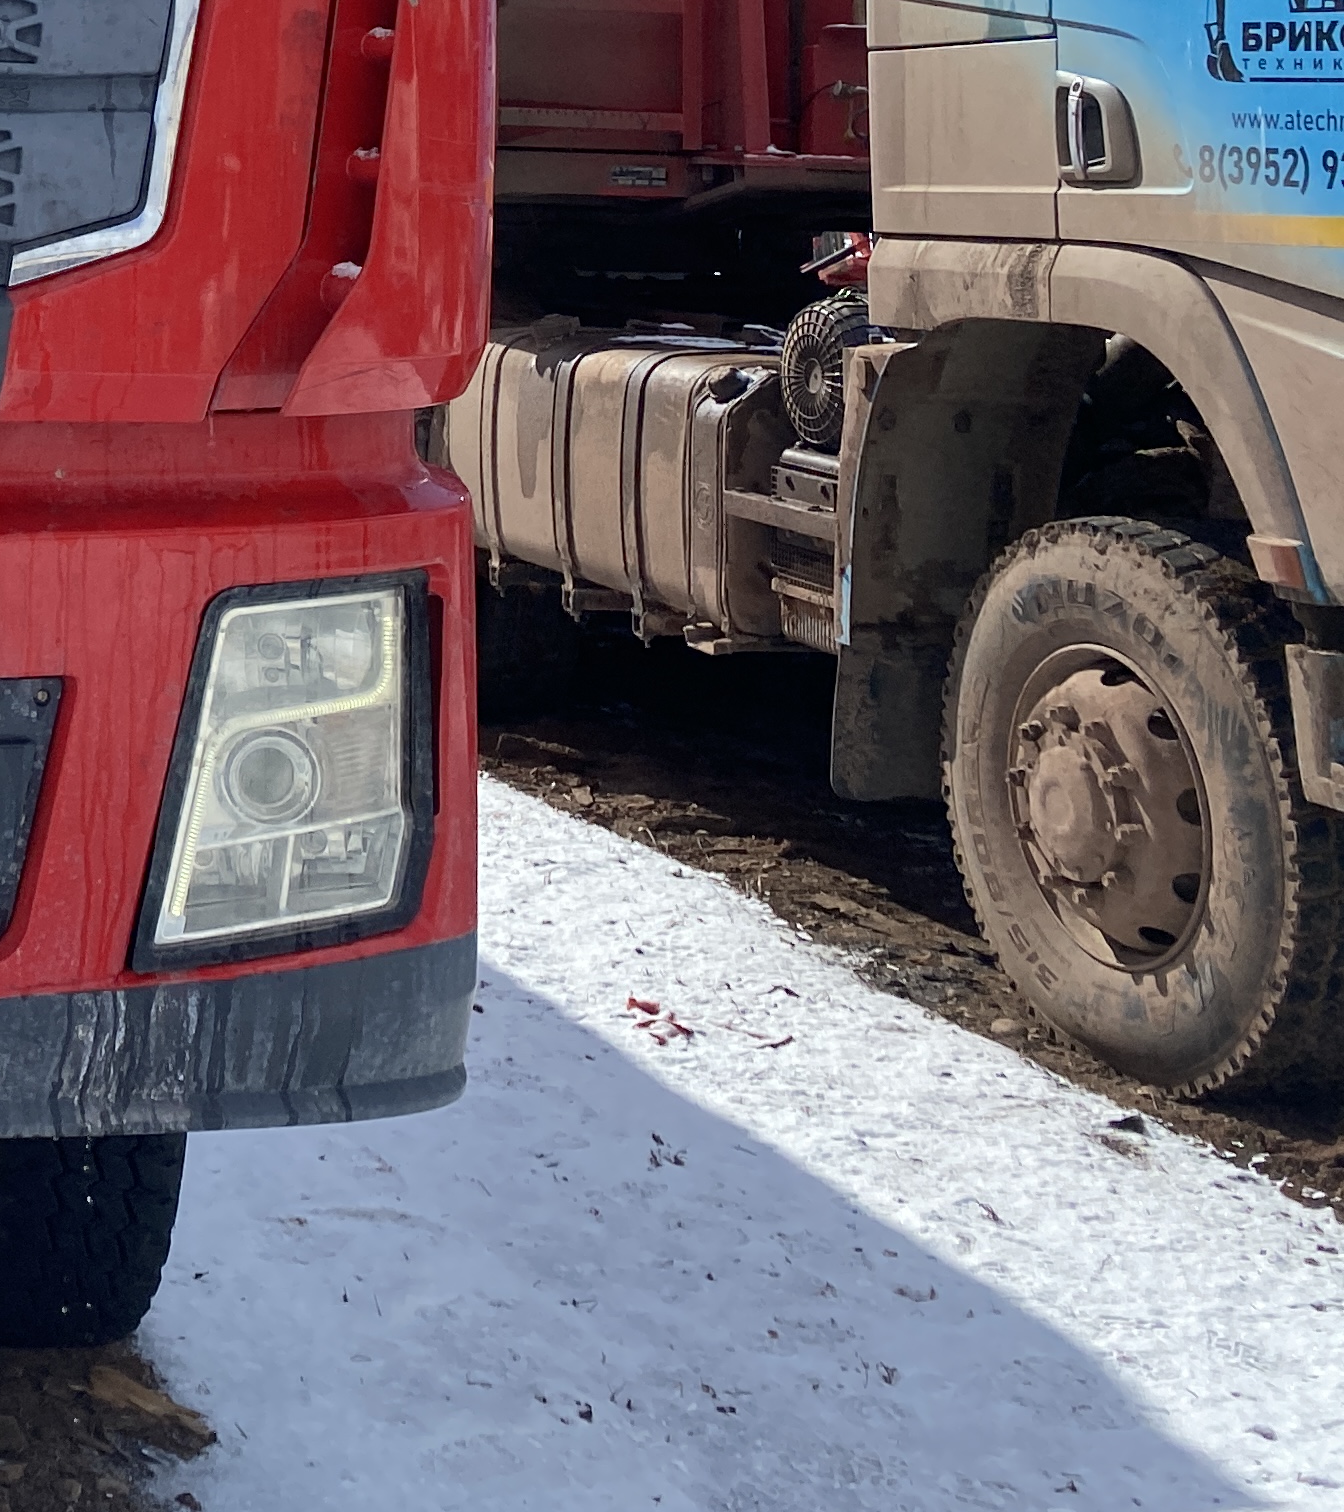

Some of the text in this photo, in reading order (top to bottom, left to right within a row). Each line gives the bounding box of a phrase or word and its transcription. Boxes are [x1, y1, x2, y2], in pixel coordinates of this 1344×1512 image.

[1242, 21, 1344, 52] БРИК
[1198, 143, 1344, 195] 8(3952) 9
